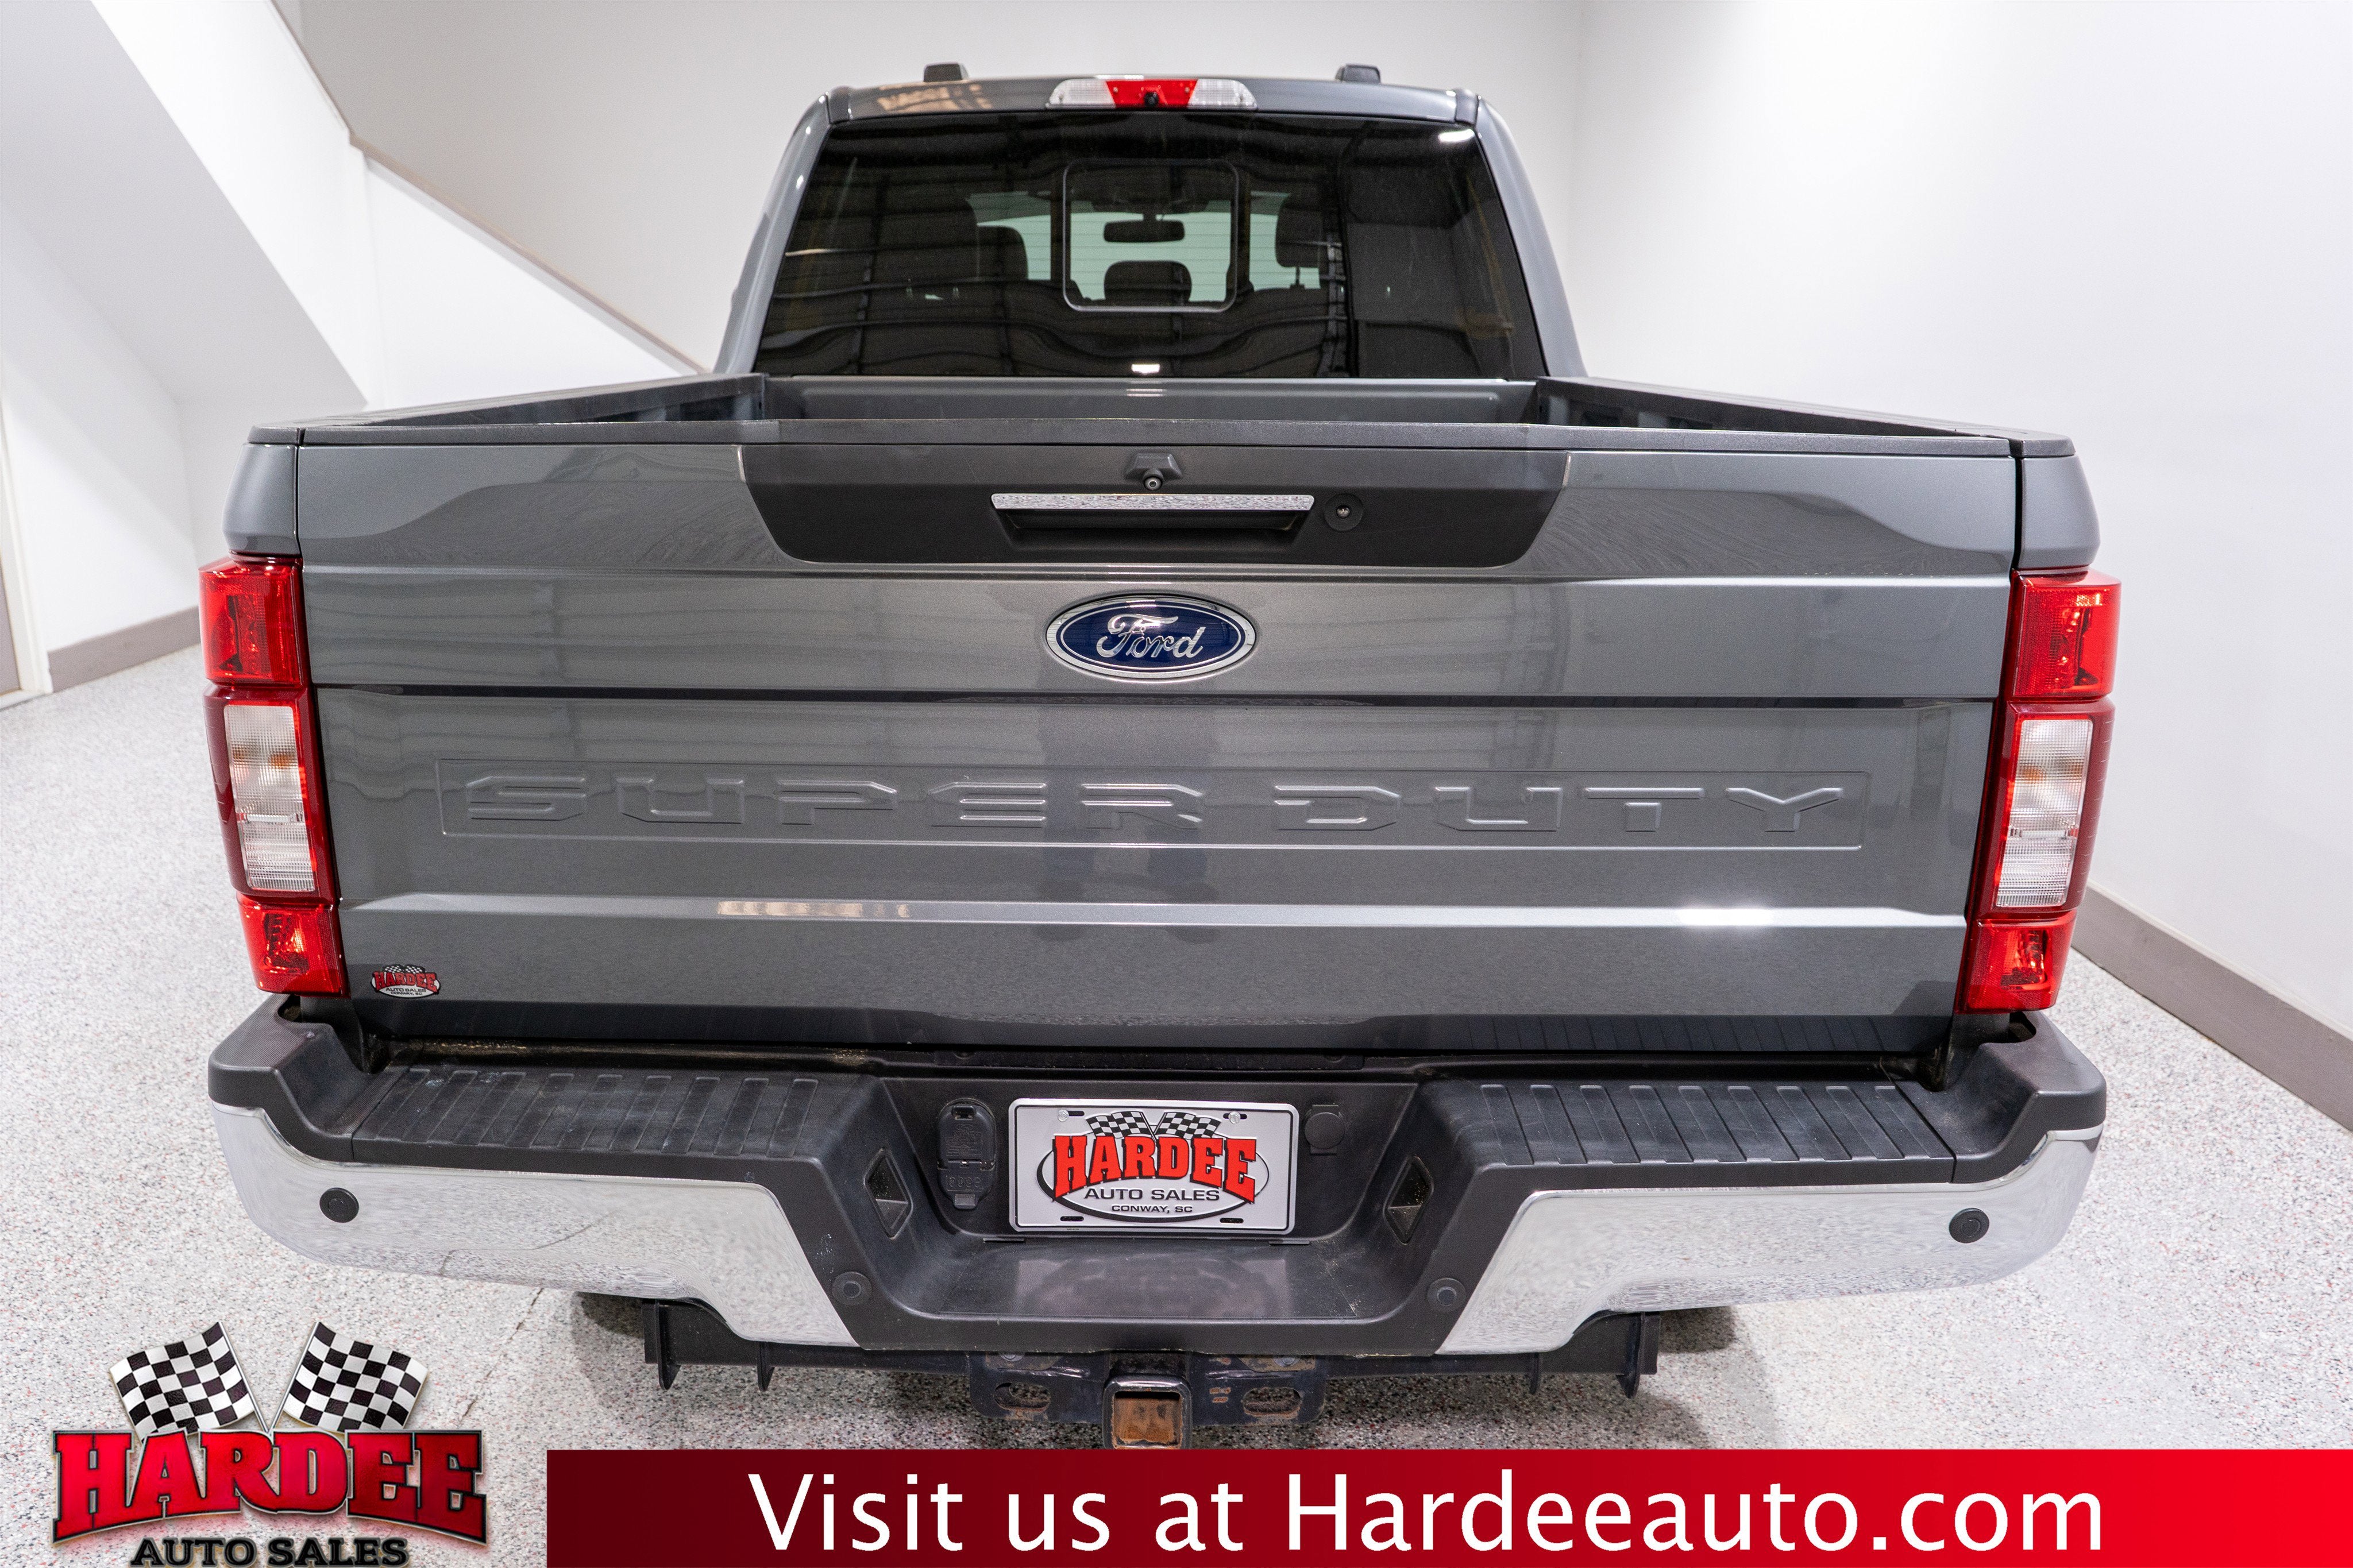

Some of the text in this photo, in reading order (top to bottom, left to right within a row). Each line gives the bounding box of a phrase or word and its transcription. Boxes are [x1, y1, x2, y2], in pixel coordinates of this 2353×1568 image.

[1096, 613, 1206, 658] Ford
[465, 775, 1843, 833] SUPER DUTY
[373, 971, 438, 993] HARDEE
[1052, 1135, 1257, 1204] HARDEE
[1084, 1188, 1220, 1201] AUTO SALES
[1111, 1204, 1170, 1214] CONWAY,
